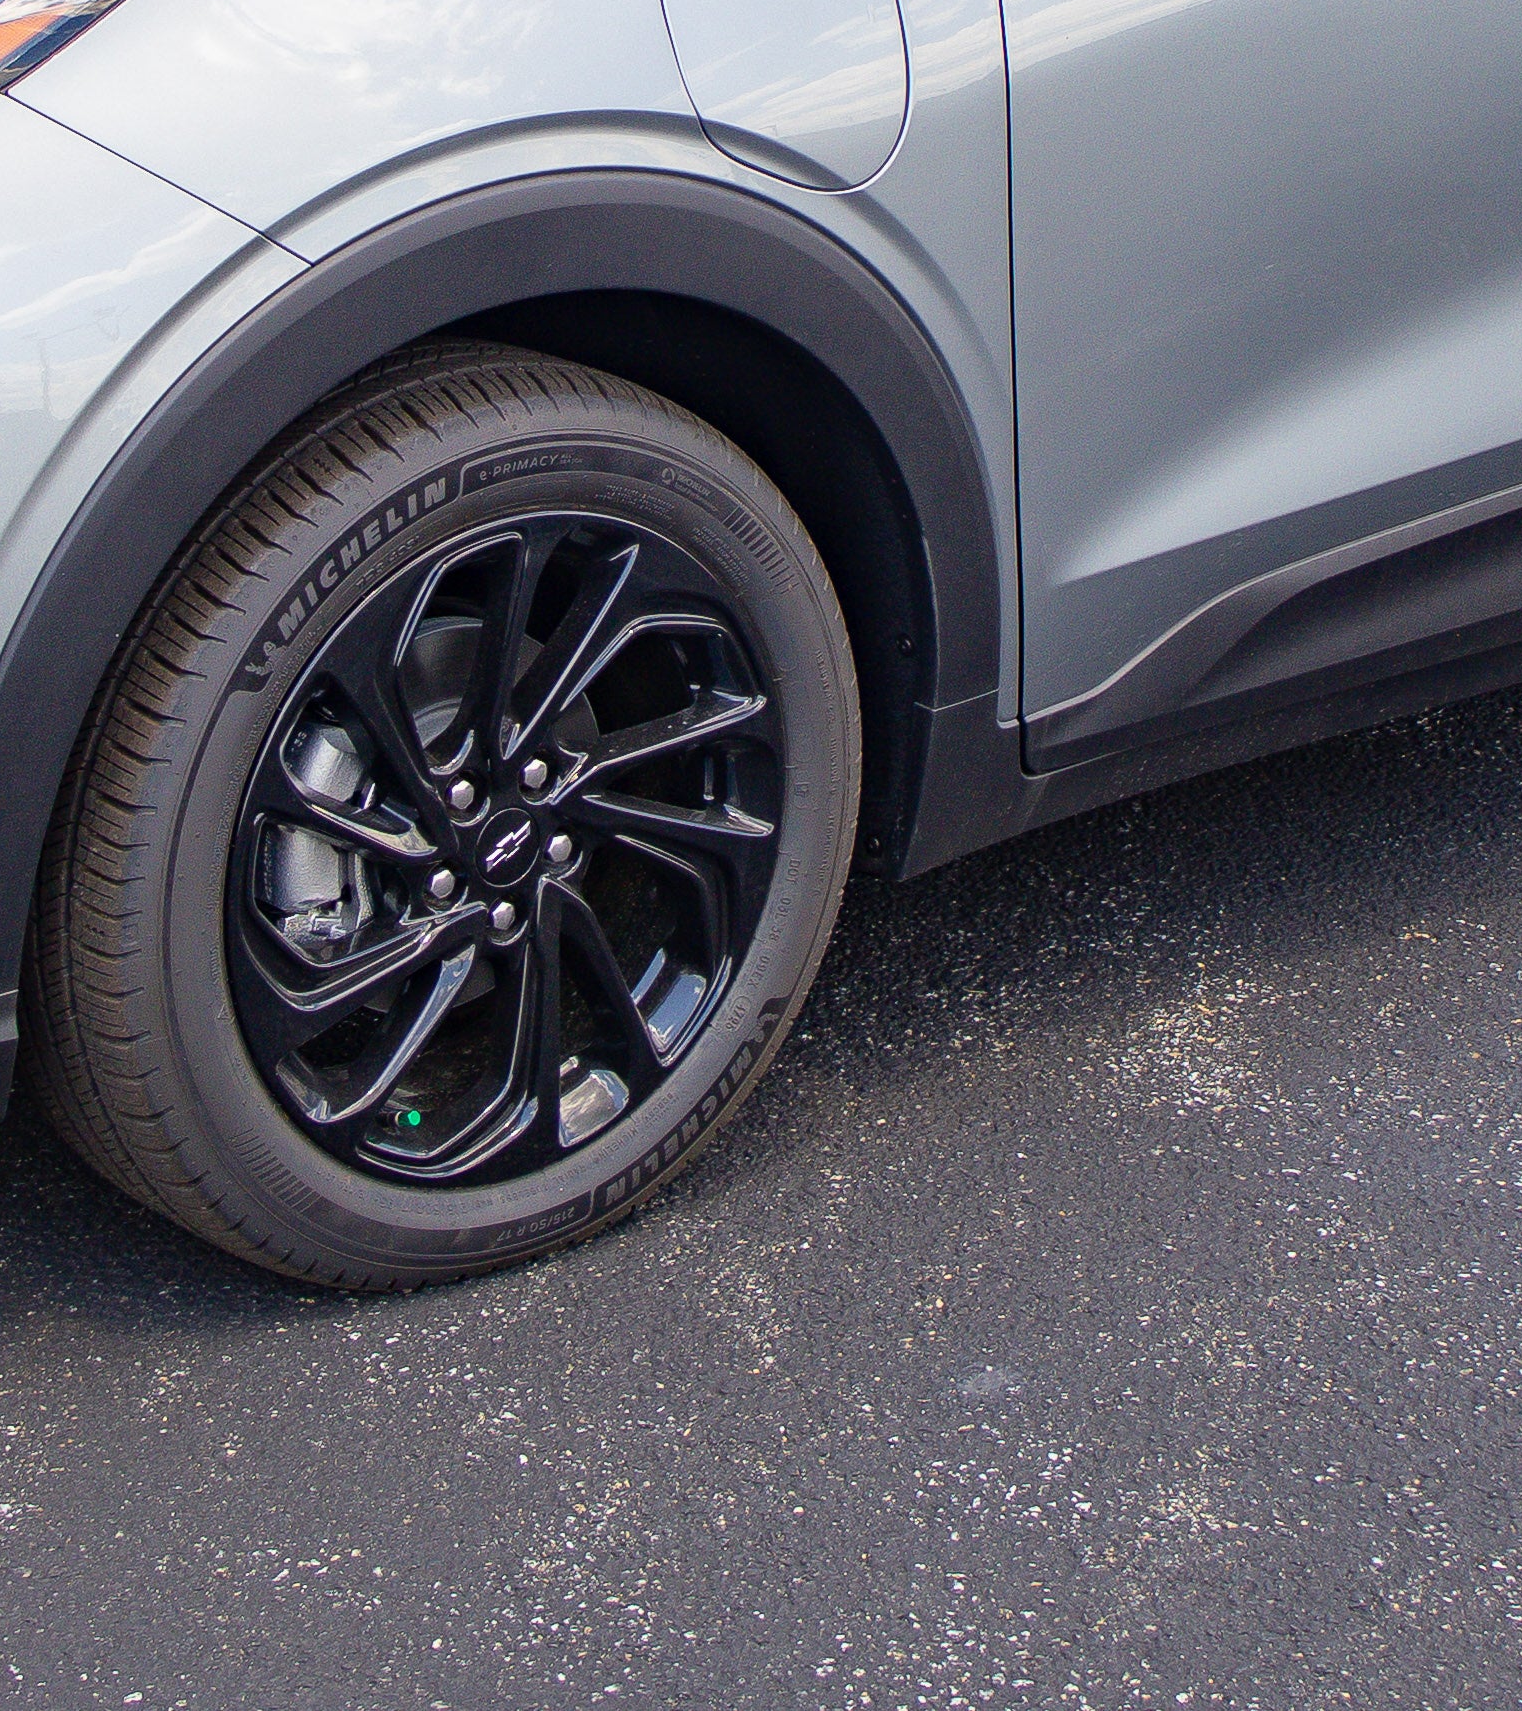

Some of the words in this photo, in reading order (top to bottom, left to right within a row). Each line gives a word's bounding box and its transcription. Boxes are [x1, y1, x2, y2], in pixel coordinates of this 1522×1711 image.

[277, 477, 446, 641] MICHELIN
[787, 858, 800, 885] DOT
[606, 1046, 753, 1207] MICHELIN
[530, 1206, 576, 1233] 215/50
